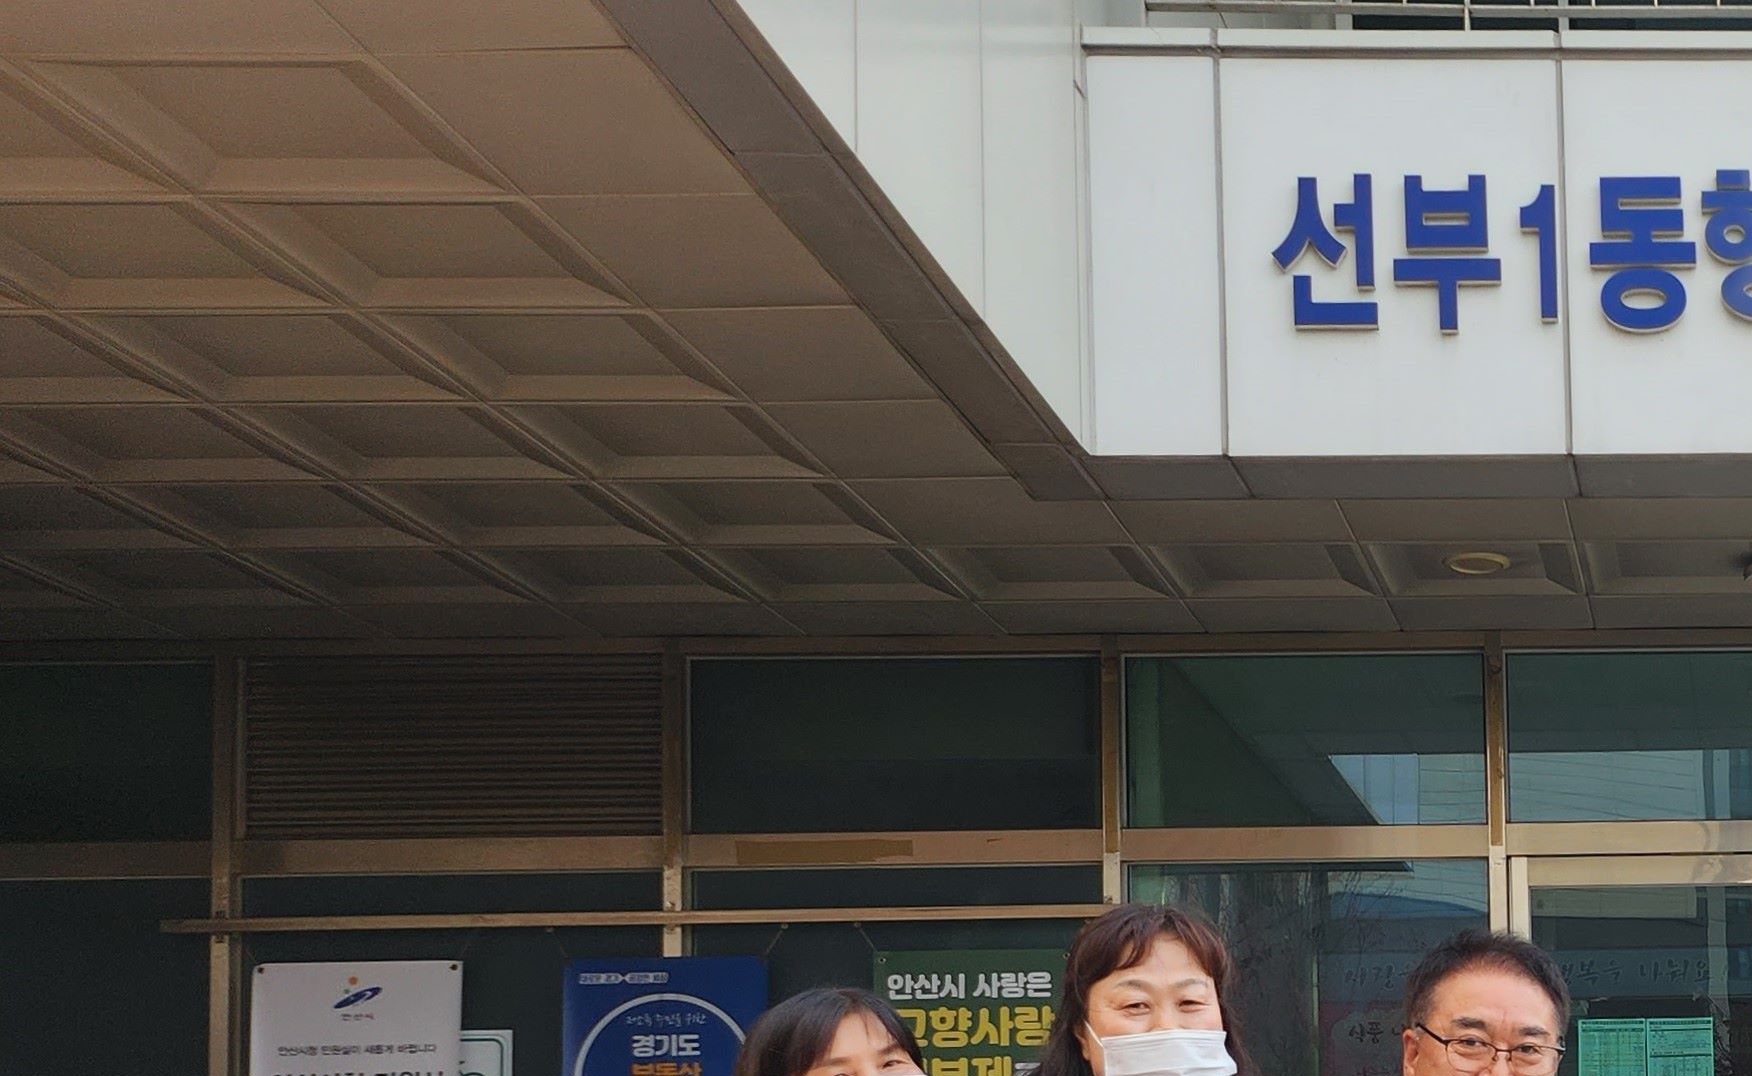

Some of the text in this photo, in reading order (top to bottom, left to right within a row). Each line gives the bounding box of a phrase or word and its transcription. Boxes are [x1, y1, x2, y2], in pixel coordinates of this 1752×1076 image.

[887, 971, 1053, 1000] 안산시 사랑은
[632, 1034, 701, 1057] 경기도
